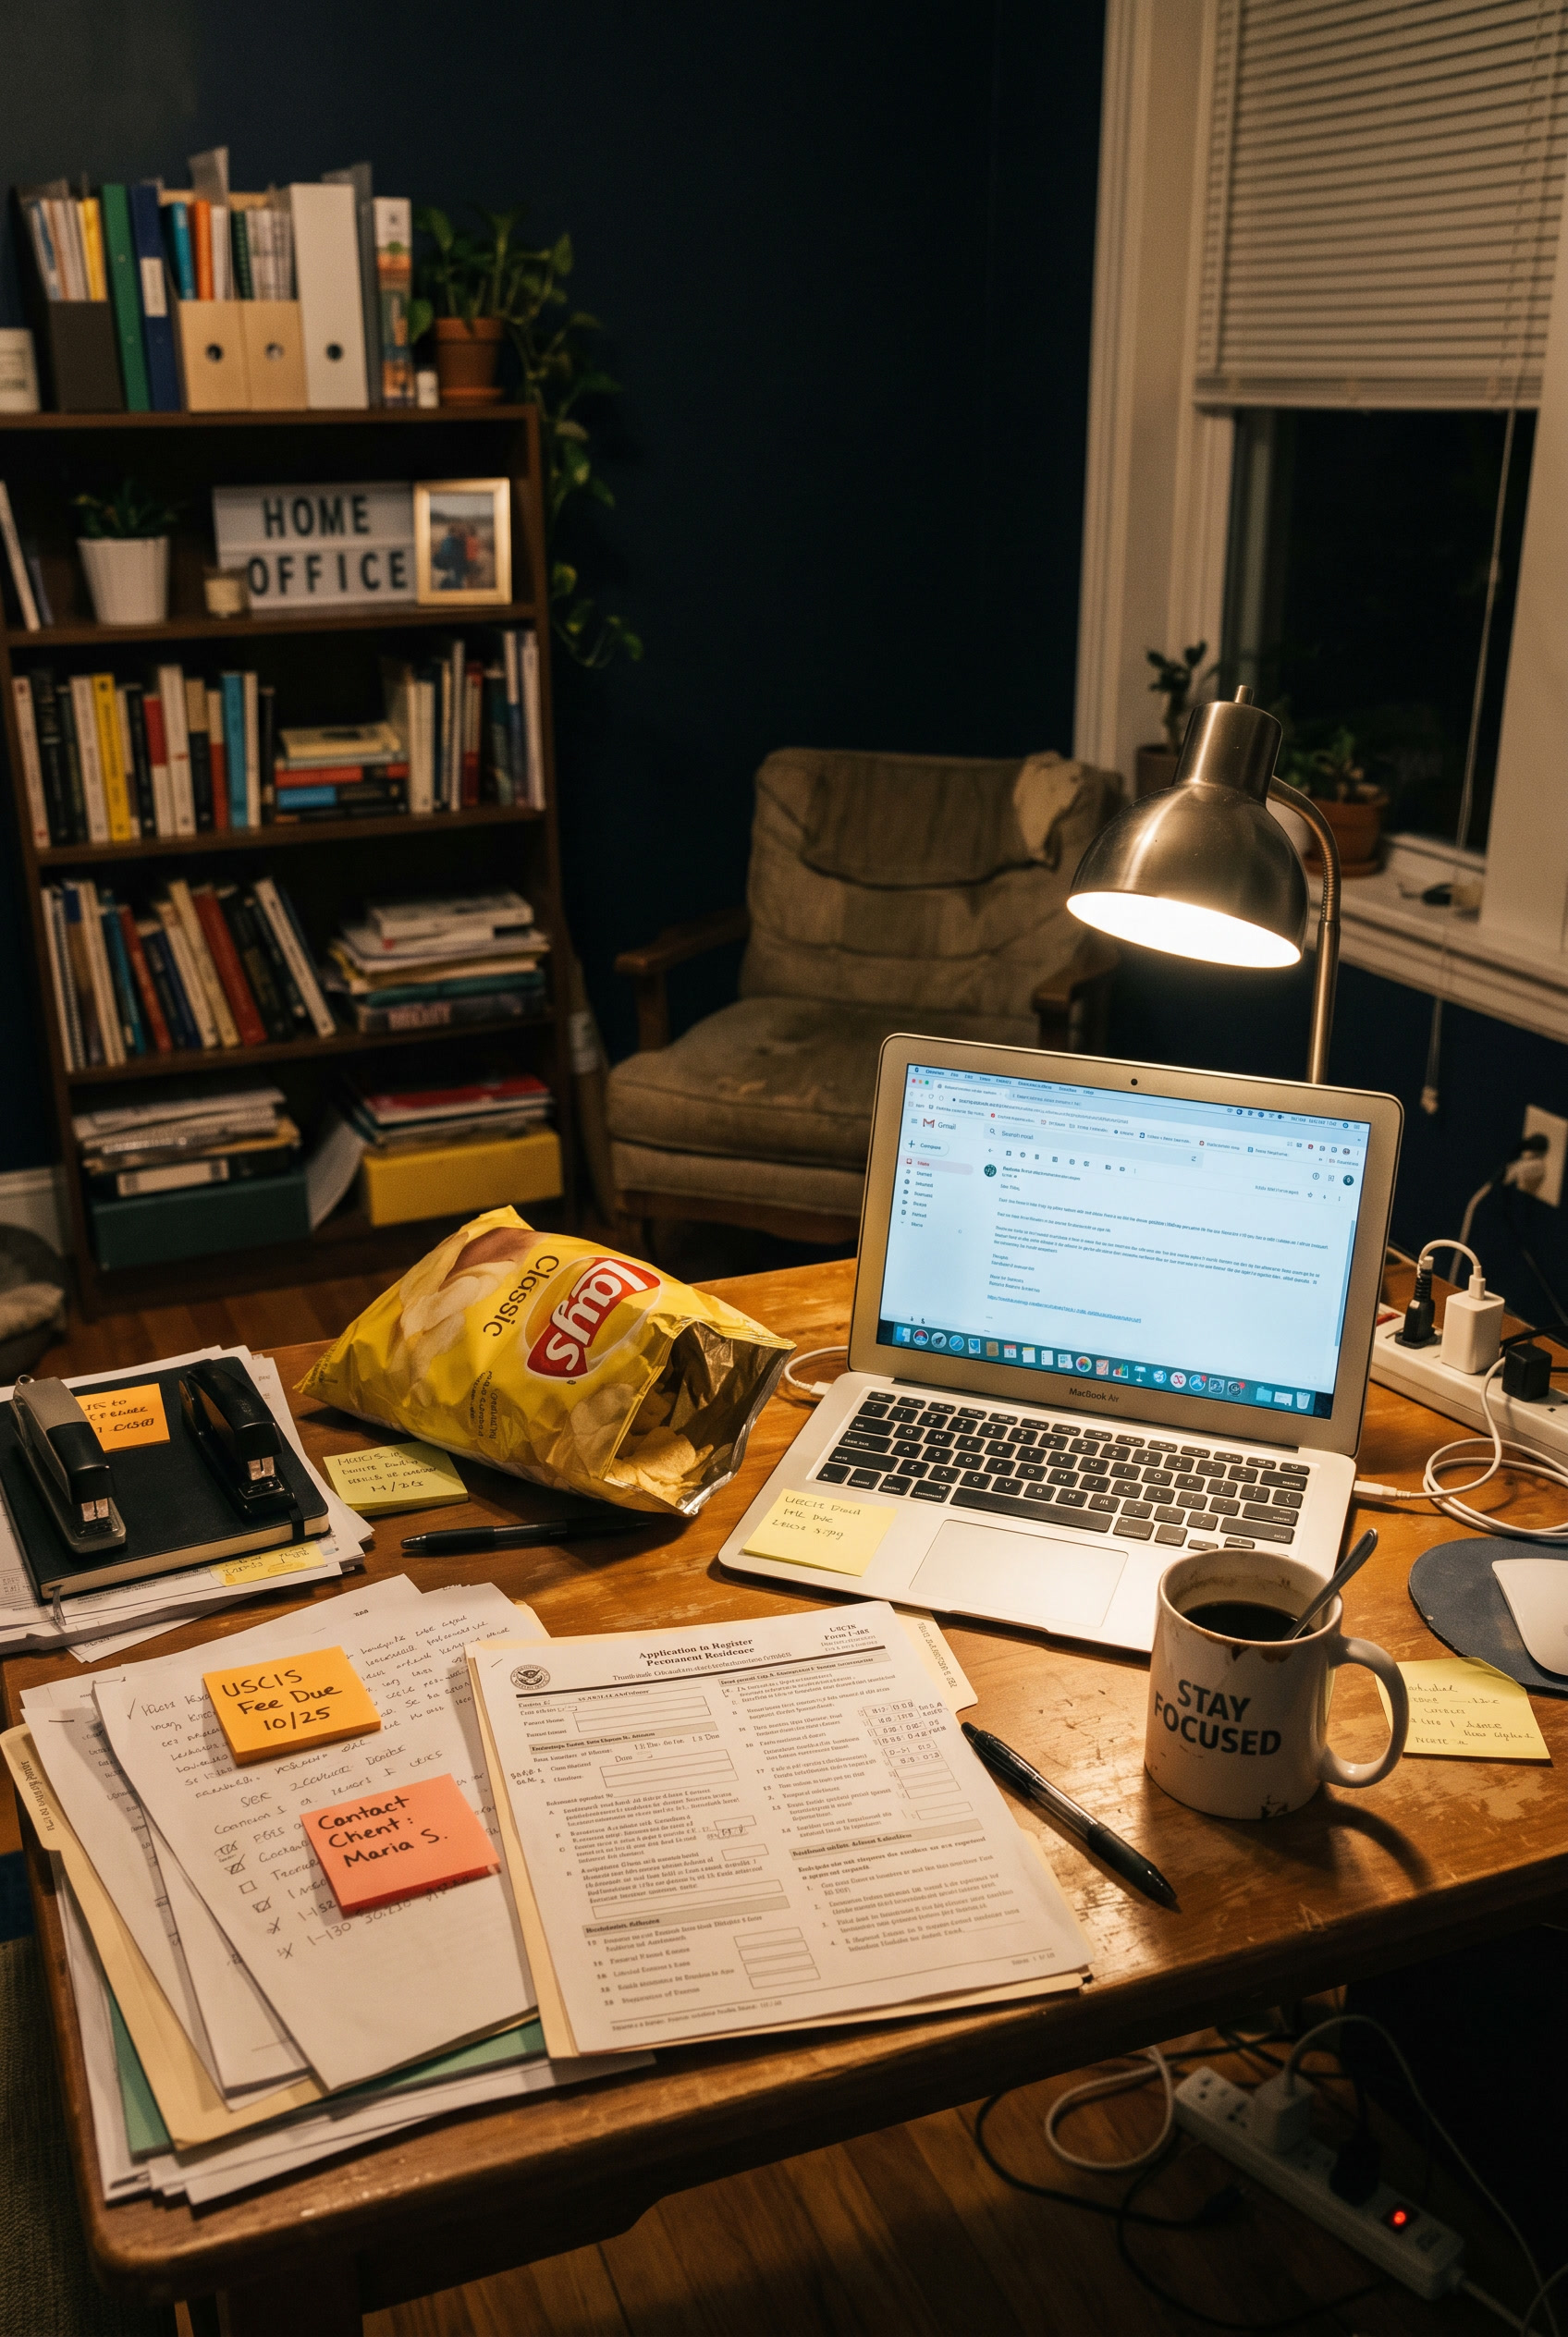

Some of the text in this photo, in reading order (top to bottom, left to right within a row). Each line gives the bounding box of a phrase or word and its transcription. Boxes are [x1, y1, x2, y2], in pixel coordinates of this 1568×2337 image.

[263, 495, 369, 538] HOME
[248, 551, 407, 595] OFFICE
[483, 1255, 559, 1337] Classic
[1069, 1388, 1106, 1401] MacBook
[639, 1647, 697, 1659] Application
[222, 1670, 302, 1697] USCIS
[237, 1685, 342, 1715] Fee Due
[1177, 1679, 1251, 1723] STAY
[263, 1707, 331, 1731] 10/25
[1154, 1690, 1281, 1756] FOCUSED
[318, 1795, 410, 1830] Contact
[343, 1829, 448, 1867] Maria S.
